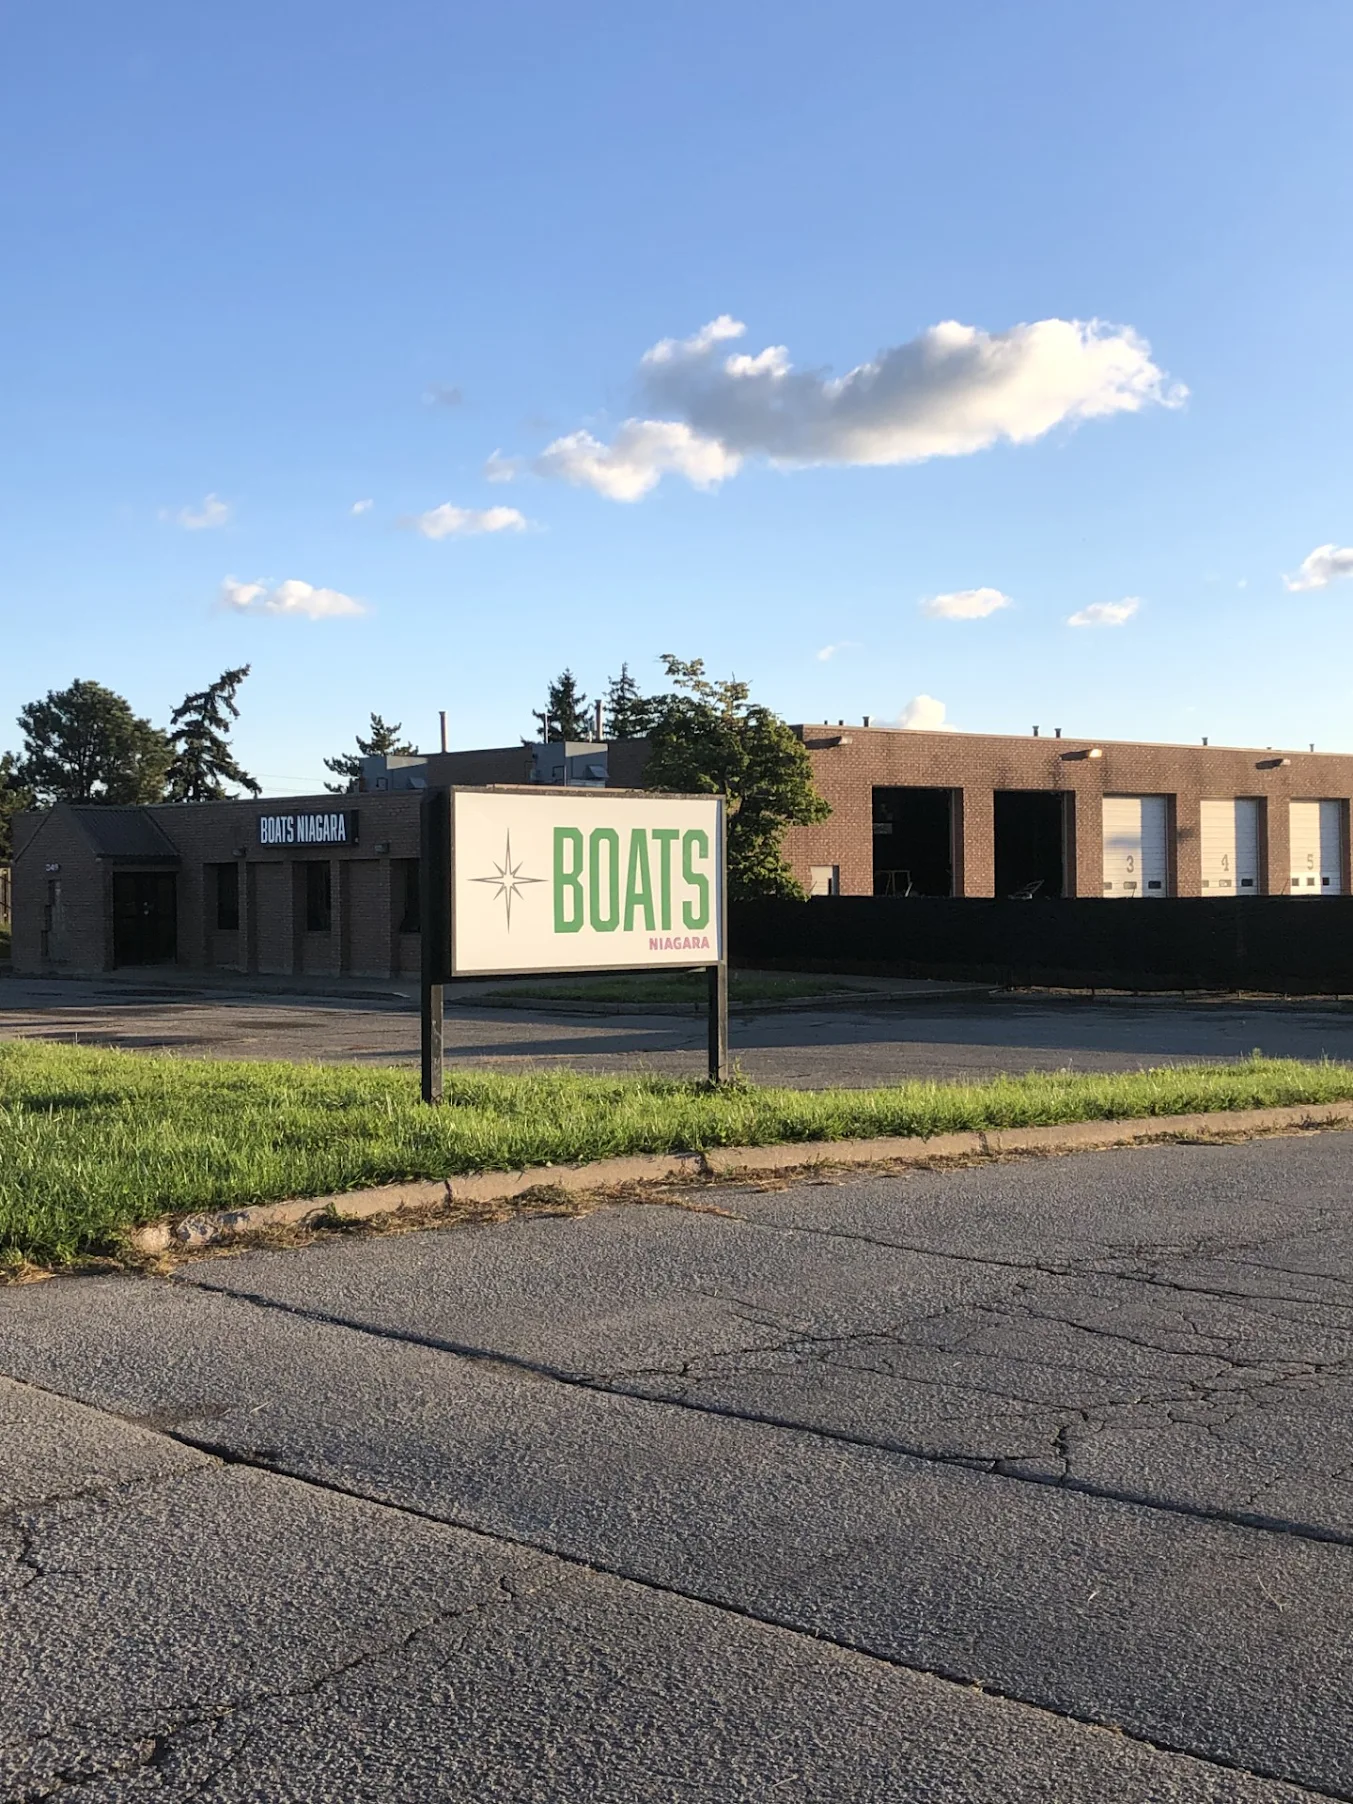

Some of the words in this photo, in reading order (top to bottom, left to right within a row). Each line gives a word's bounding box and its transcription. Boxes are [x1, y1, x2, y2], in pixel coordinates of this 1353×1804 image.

[260, 816, 294, 843] BOATS
[297, 814, 346, 842] NIAGARA
[1126, 855, 1134, 873] 3
[1307, 853, 1314, 870] 5
[553, 827, 709, 933] BOATS
[649, 936, 710, 950] NIAGARA
